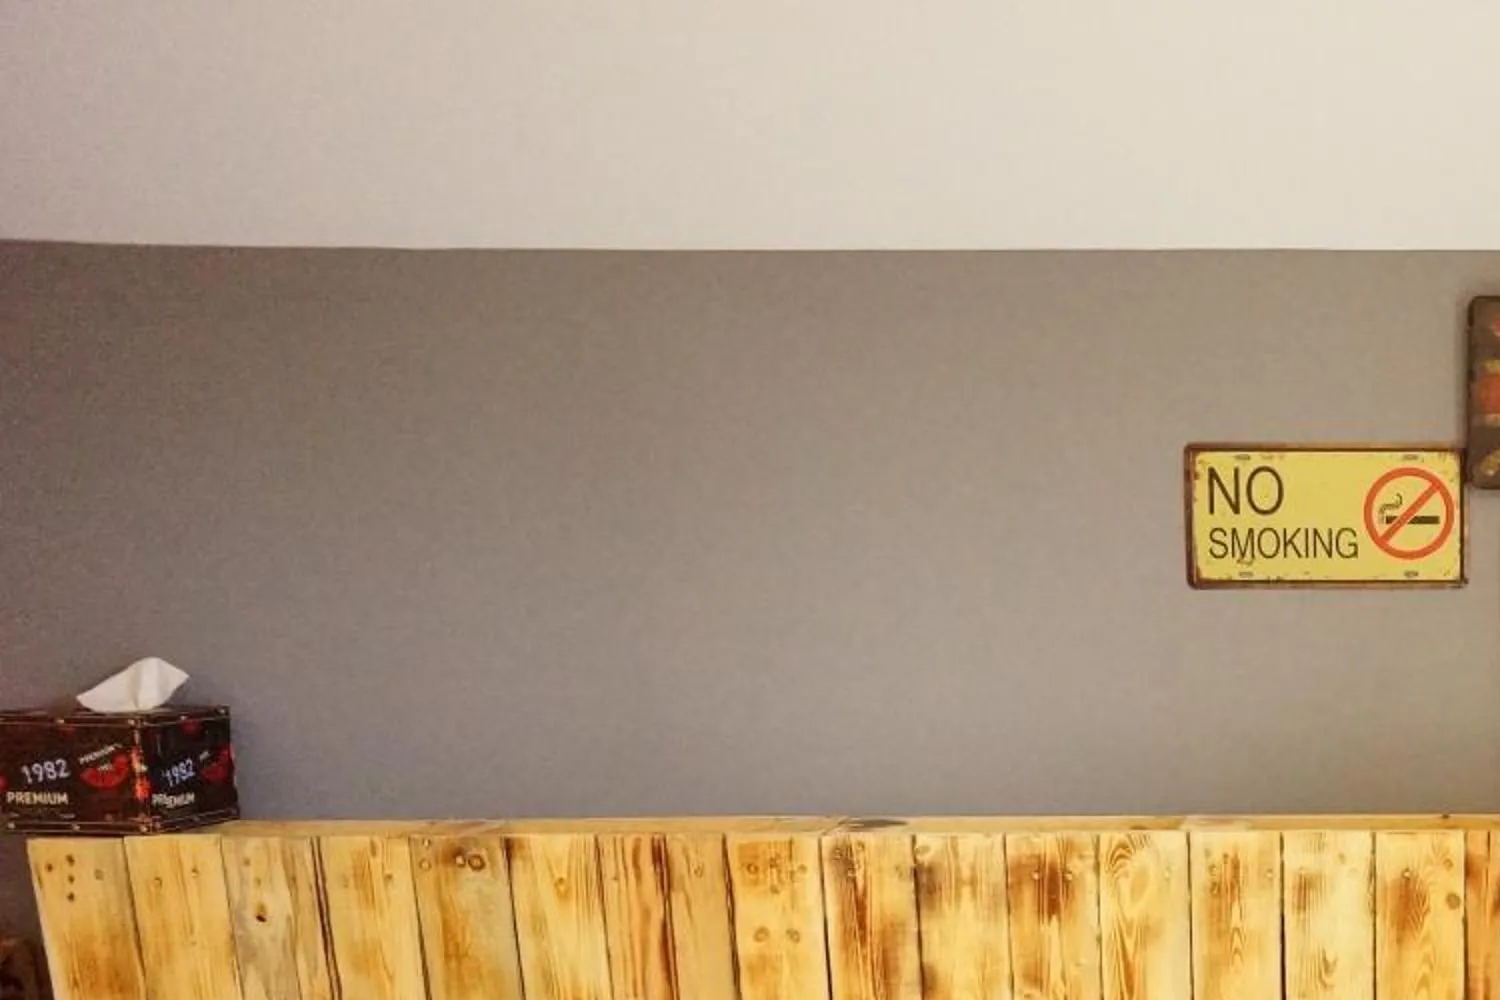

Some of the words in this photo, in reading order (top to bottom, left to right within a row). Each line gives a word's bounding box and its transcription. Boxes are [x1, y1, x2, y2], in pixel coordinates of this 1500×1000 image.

[1207, 466, 1285, 516] NO
[1208, 527, 1360, 559] SMOKING
[21, 758, 71, 785] 1982
[6, 791, 69, 805] PREMIUM
